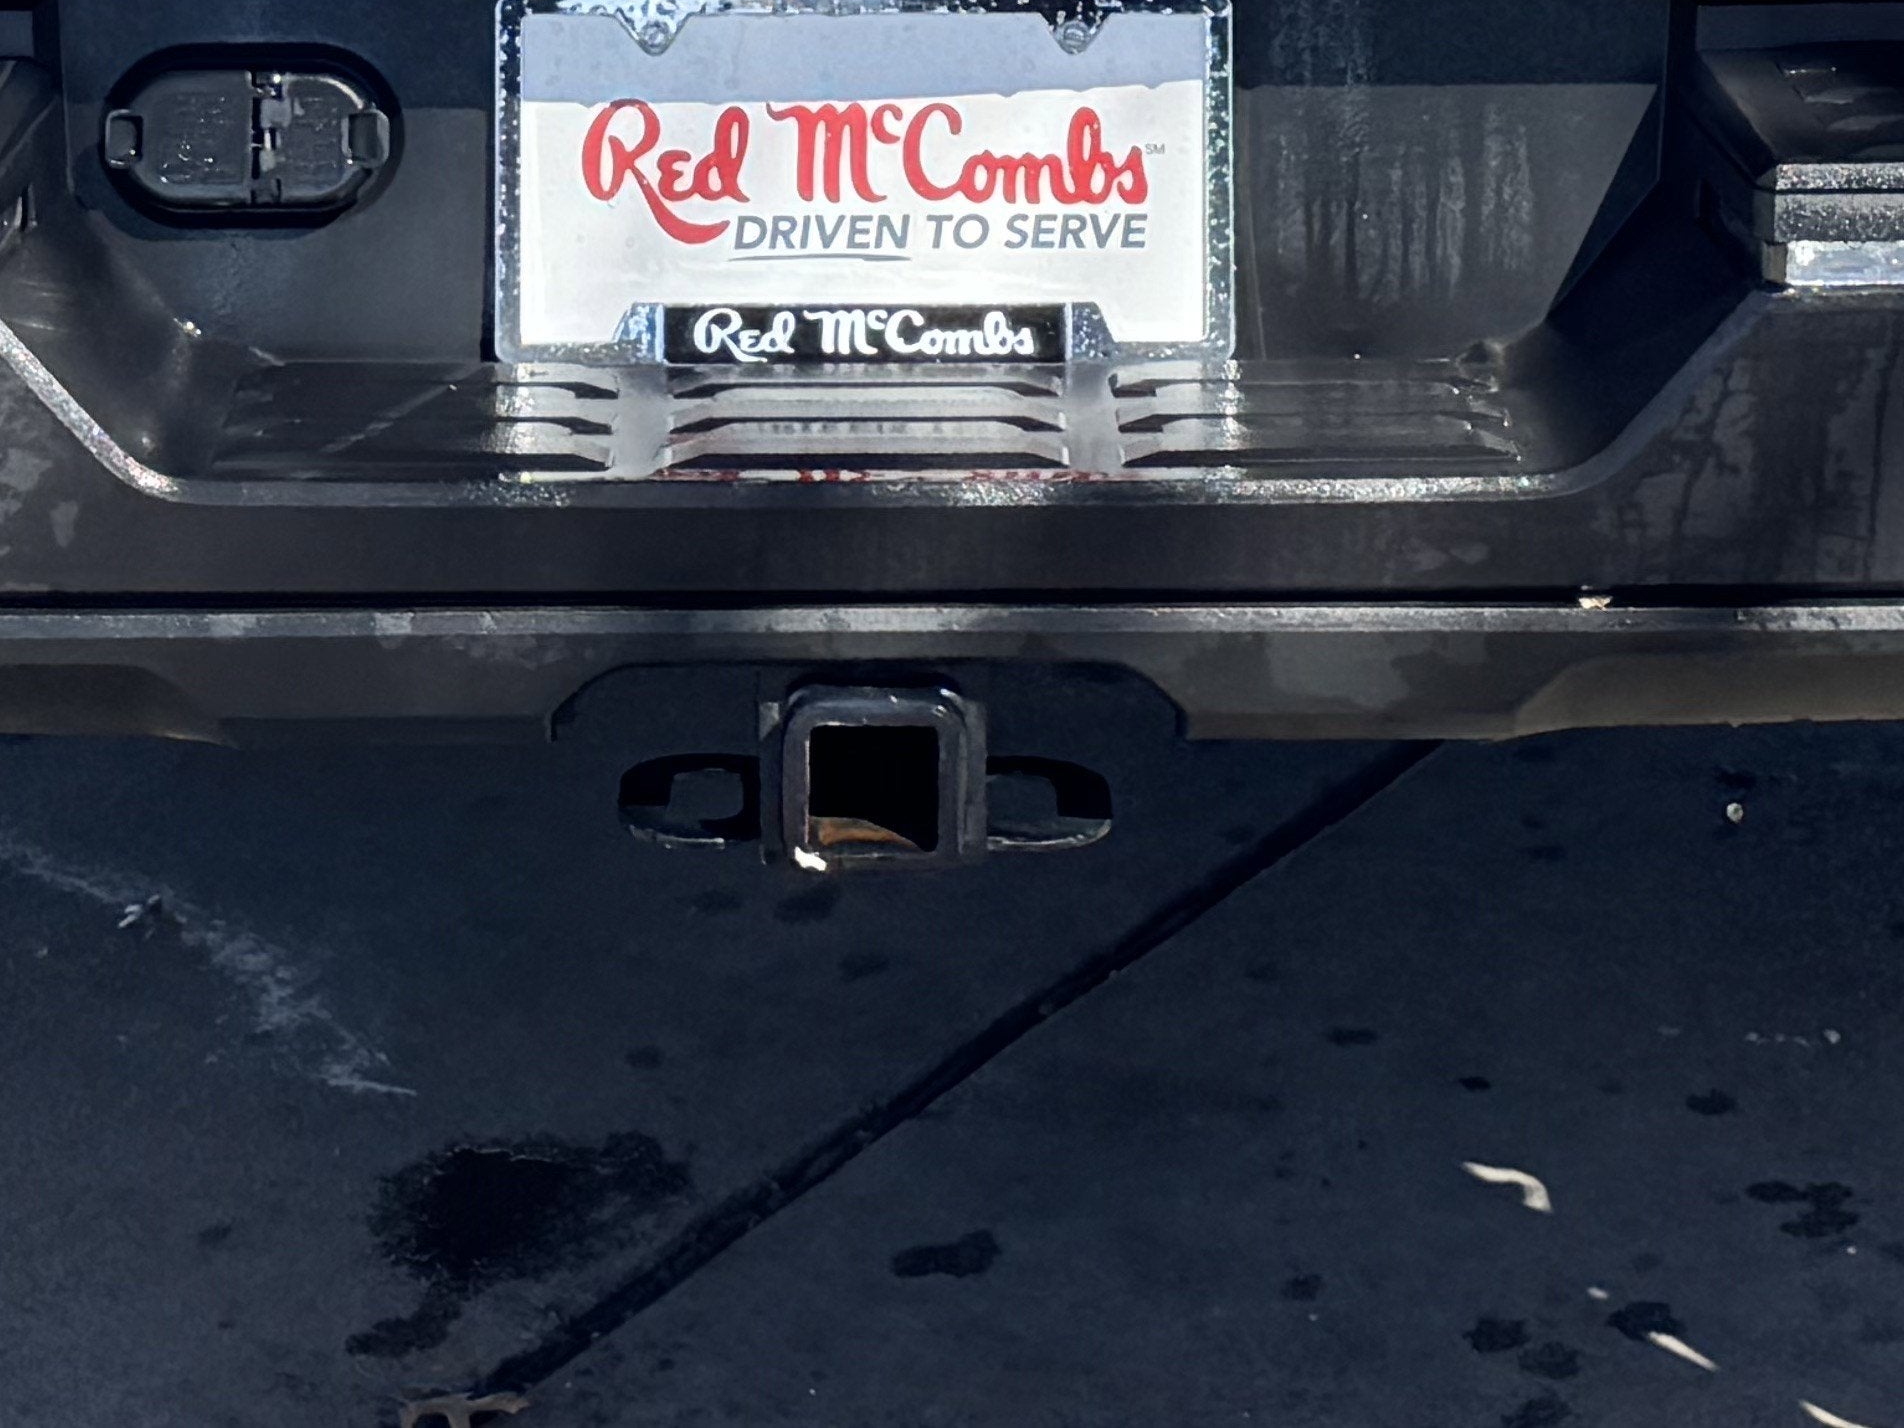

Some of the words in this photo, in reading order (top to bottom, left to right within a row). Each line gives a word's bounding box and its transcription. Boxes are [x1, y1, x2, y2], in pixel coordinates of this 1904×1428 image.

[581, 98, 750, 245] Red
[765, 101, 1148, 206] McCombs
[732, 214, 911, 251] DRIVEN
[931, 214, 992, 250] TO
[1004, 213, 1150, 250] SERVE
[693, 307, 796, 364] Red
[803, 309, 1035, 356] McCombs
